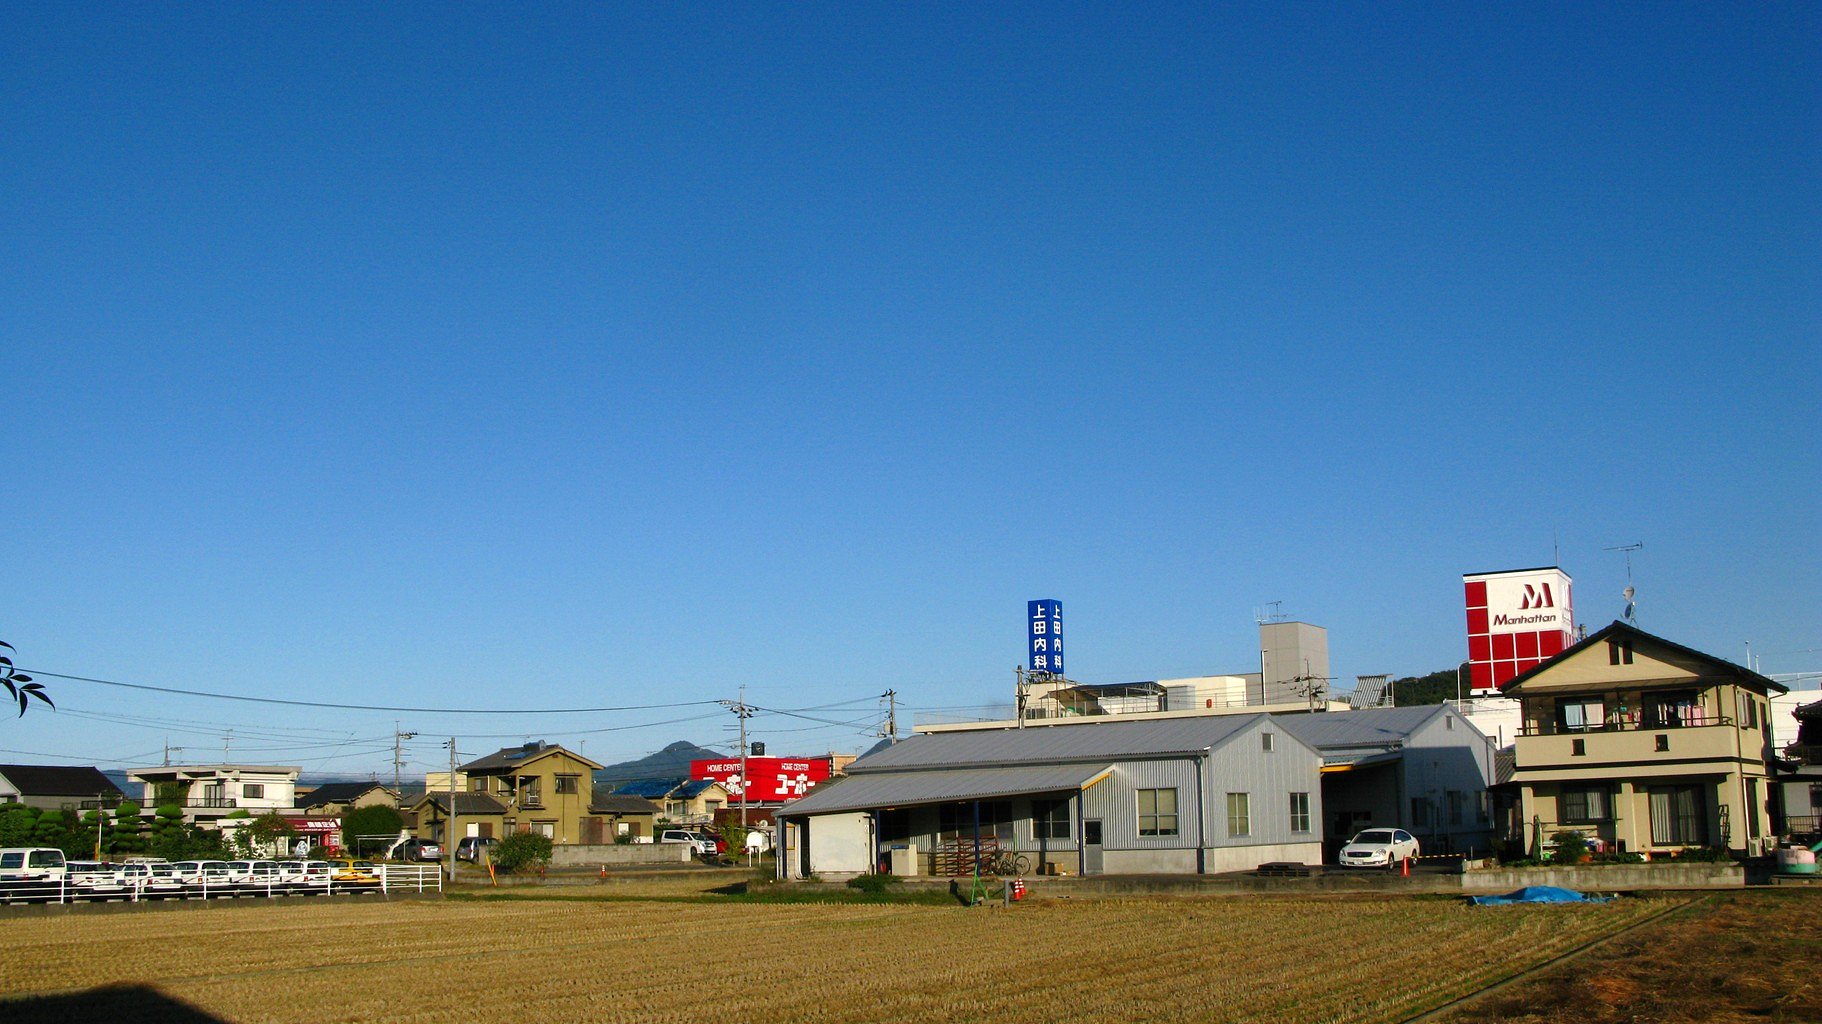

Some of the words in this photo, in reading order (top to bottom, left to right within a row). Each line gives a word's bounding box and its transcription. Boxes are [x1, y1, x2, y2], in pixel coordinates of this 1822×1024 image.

[1493, 614, 1556, 626] Manhattan
[1033, 604, 1047, 669] 上田内科
[1053, 604, 1062, 669] 上田内科
[707, 764, 723, 772] HOME
[723, 763, 742, 772] CENTE
[781, 763, 793, 771] HOME
[793, 763, 809, 771] CENTER
[703, 774, 751, 794] ーホー
[775, 773, 815, 794] ユーホー
